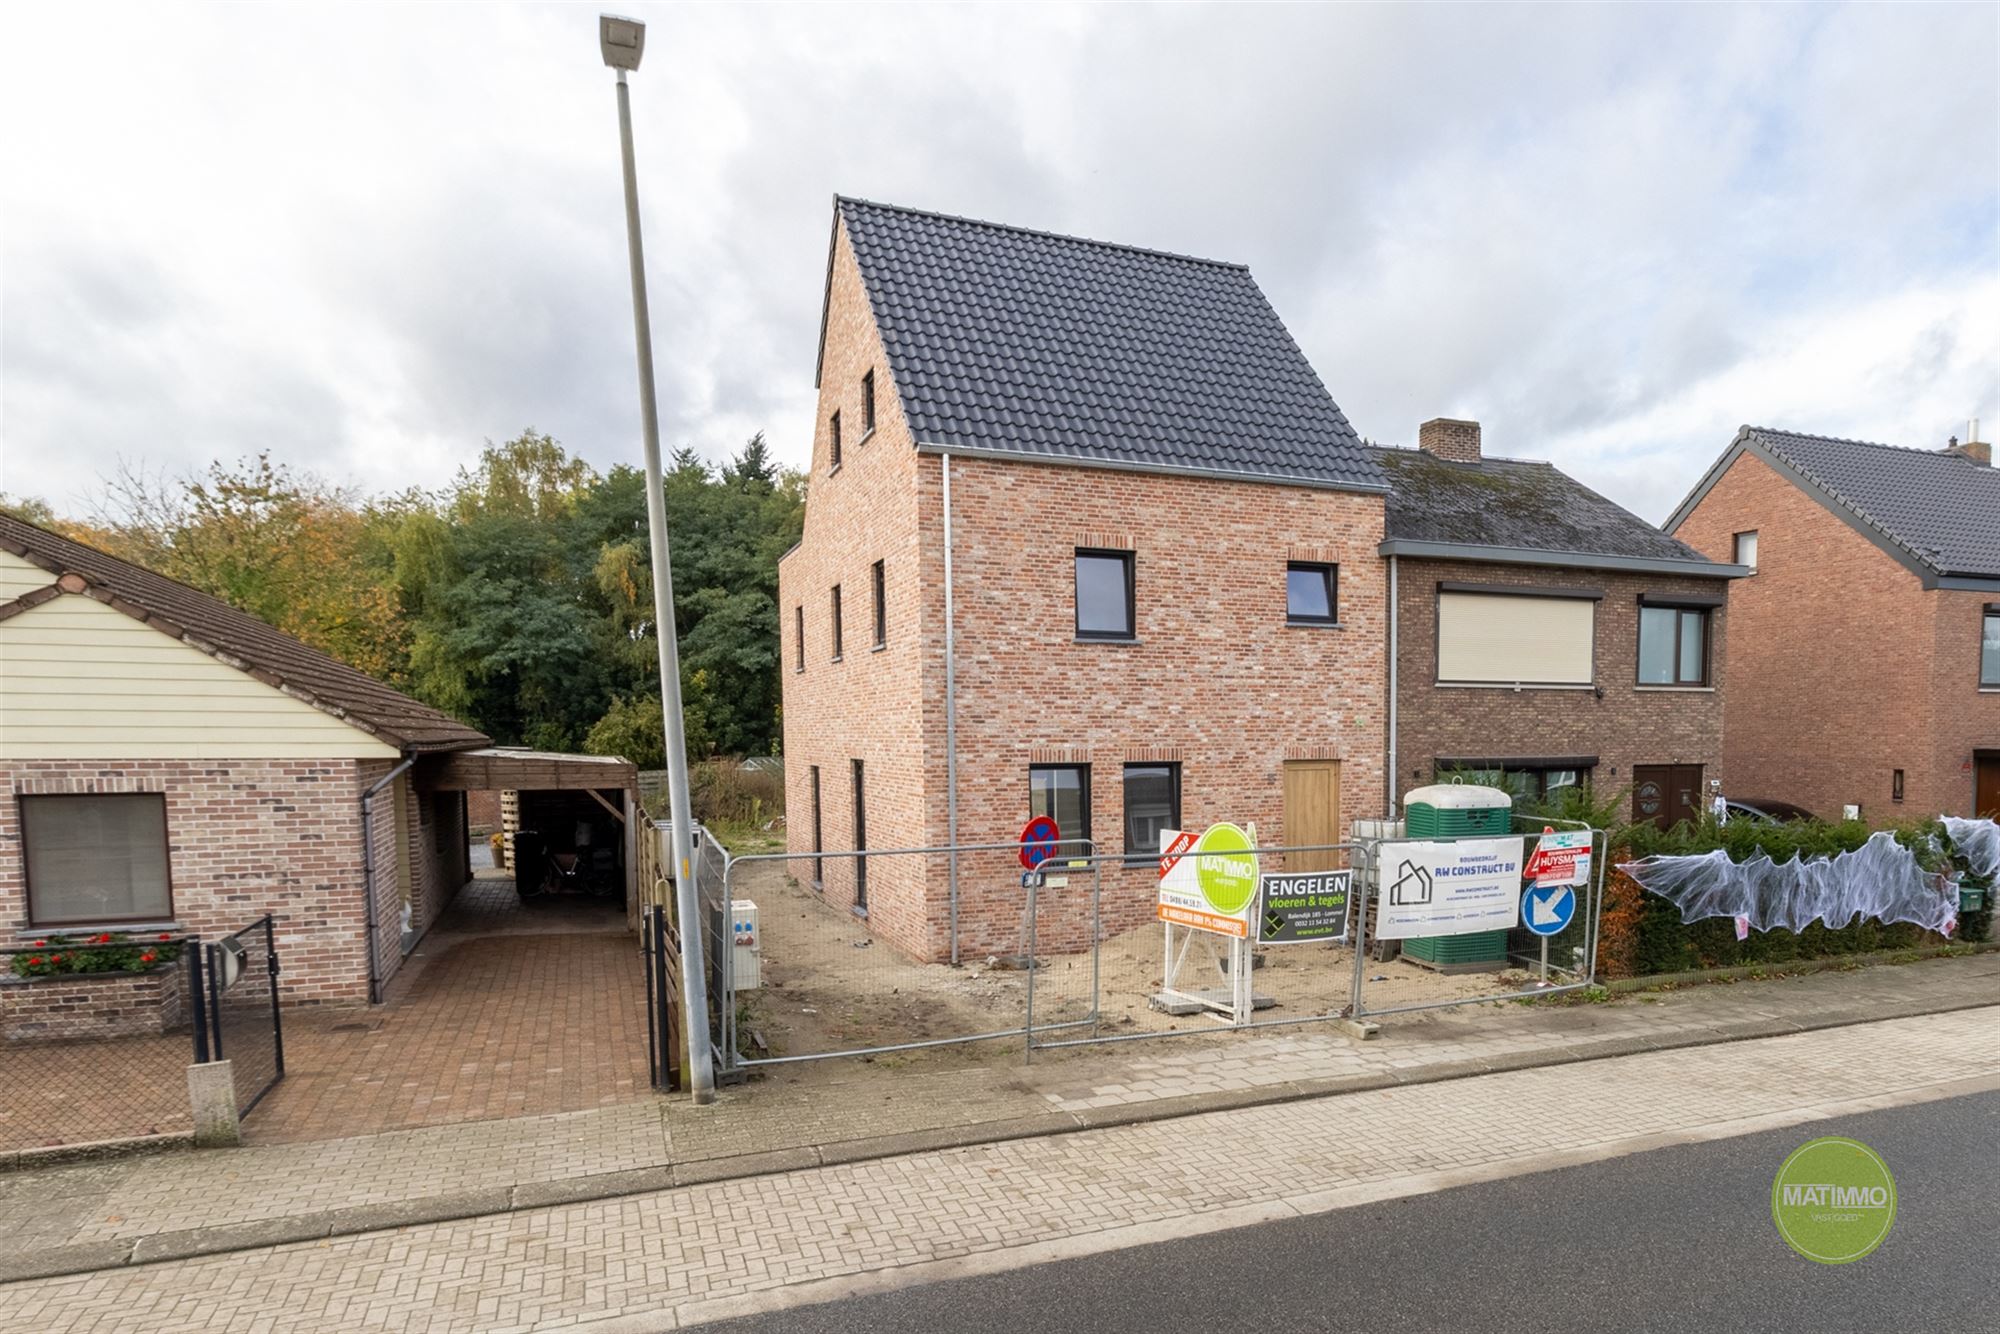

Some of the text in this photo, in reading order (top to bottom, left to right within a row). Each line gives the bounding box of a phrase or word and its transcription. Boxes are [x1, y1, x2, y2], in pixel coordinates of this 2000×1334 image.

[1161, 857, 1172, 871] TE
[1460, 855, 1497, 863] BOUWBEDRIJF
[1201, 856, 1252, 878] MATIMMO
[1435, 863, 1515, 877] RW CONSTRUCT BV
[1269, 876, 1346, 896] ENGELEN
[1268, 894, 1345, 908] vloeren & tegels
